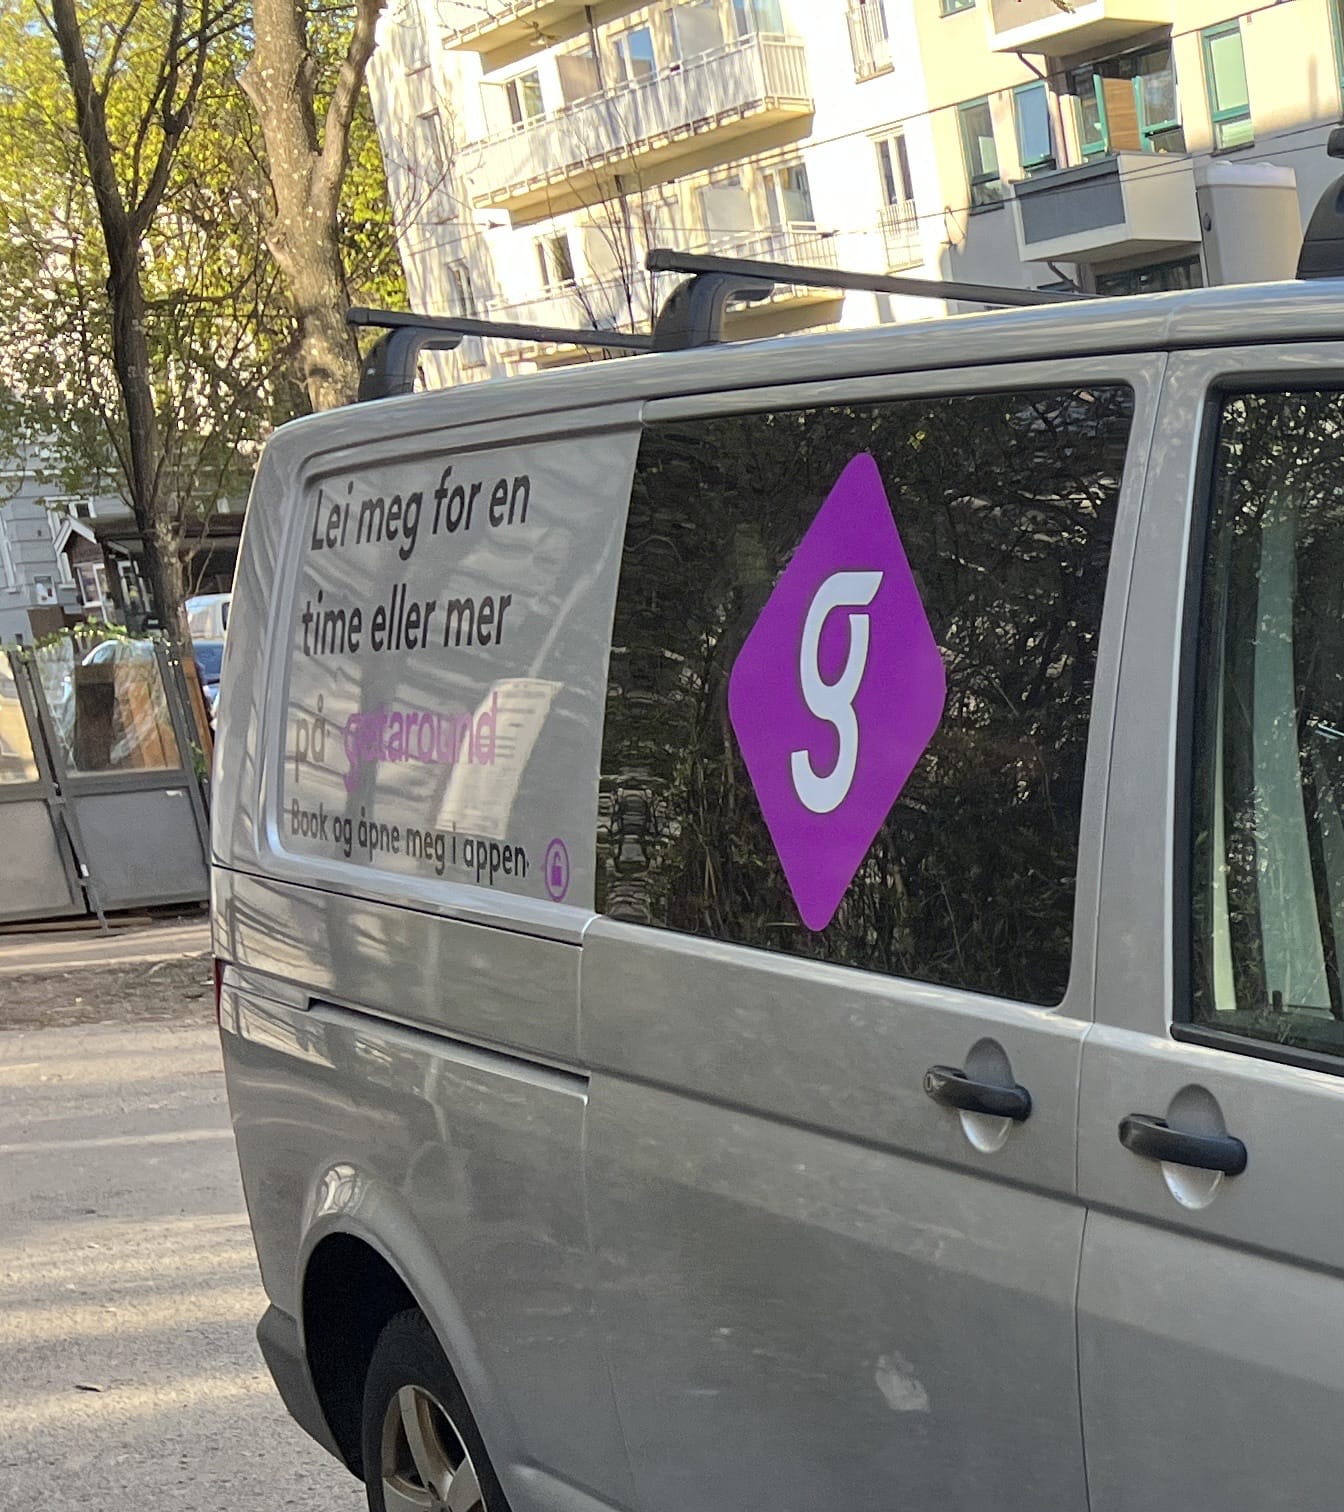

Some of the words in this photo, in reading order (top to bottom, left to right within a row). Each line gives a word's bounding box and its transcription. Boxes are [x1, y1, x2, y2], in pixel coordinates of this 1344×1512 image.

[311, 480, 354, 550] Lei
[355, 492, 424, 560] meg
[432, 466, 482, 535] for
[488, 474, 530, 527] en
[302, 590, 362, 656] time
[371, 583, 436, 651] eller
[443, 594, 512, 647] mer
[295, 693, 326, 784] på
[343, 691, 498, 793] getaround
[291, 799, 328, 840] Book
[333, 818, 353, 858] og
[358, 806, 400, 862] åpne
[406, 827, 446, 876] meg
[463, 837, 526, 886] appen
